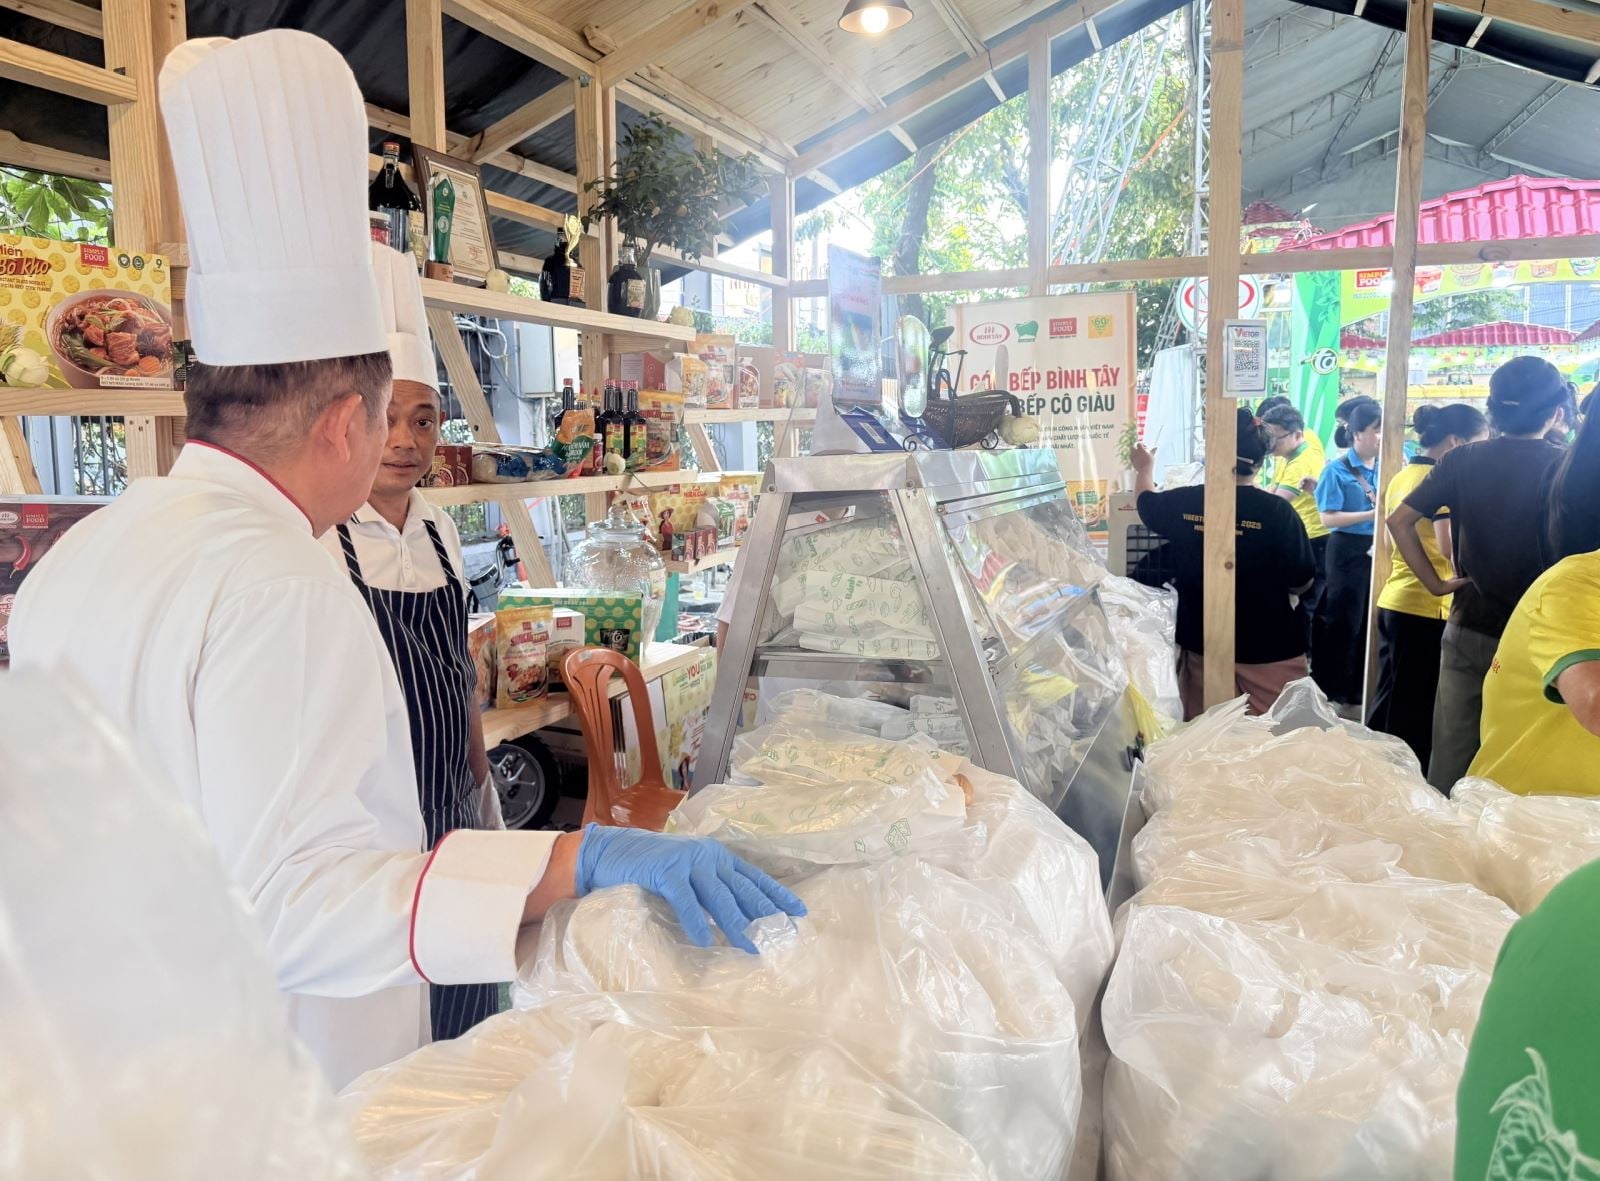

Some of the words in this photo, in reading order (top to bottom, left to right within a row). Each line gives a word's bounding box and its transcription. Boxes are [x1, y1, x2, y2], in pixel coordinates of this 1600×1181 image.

[84, 253, 105, 262] FOOD
[155, 258, 162, 269] 9
[1053, 325, 1073, 333] FOOD
[1009, 366, 1041, 391] BẾP
[1046, 366, 1087, 390] BÌNH
[1091, 364, 1120, 388] TÂY
[1051, 393, 1072, 415] CÔ
[1077, 393, 1115, 413] GIÀU
